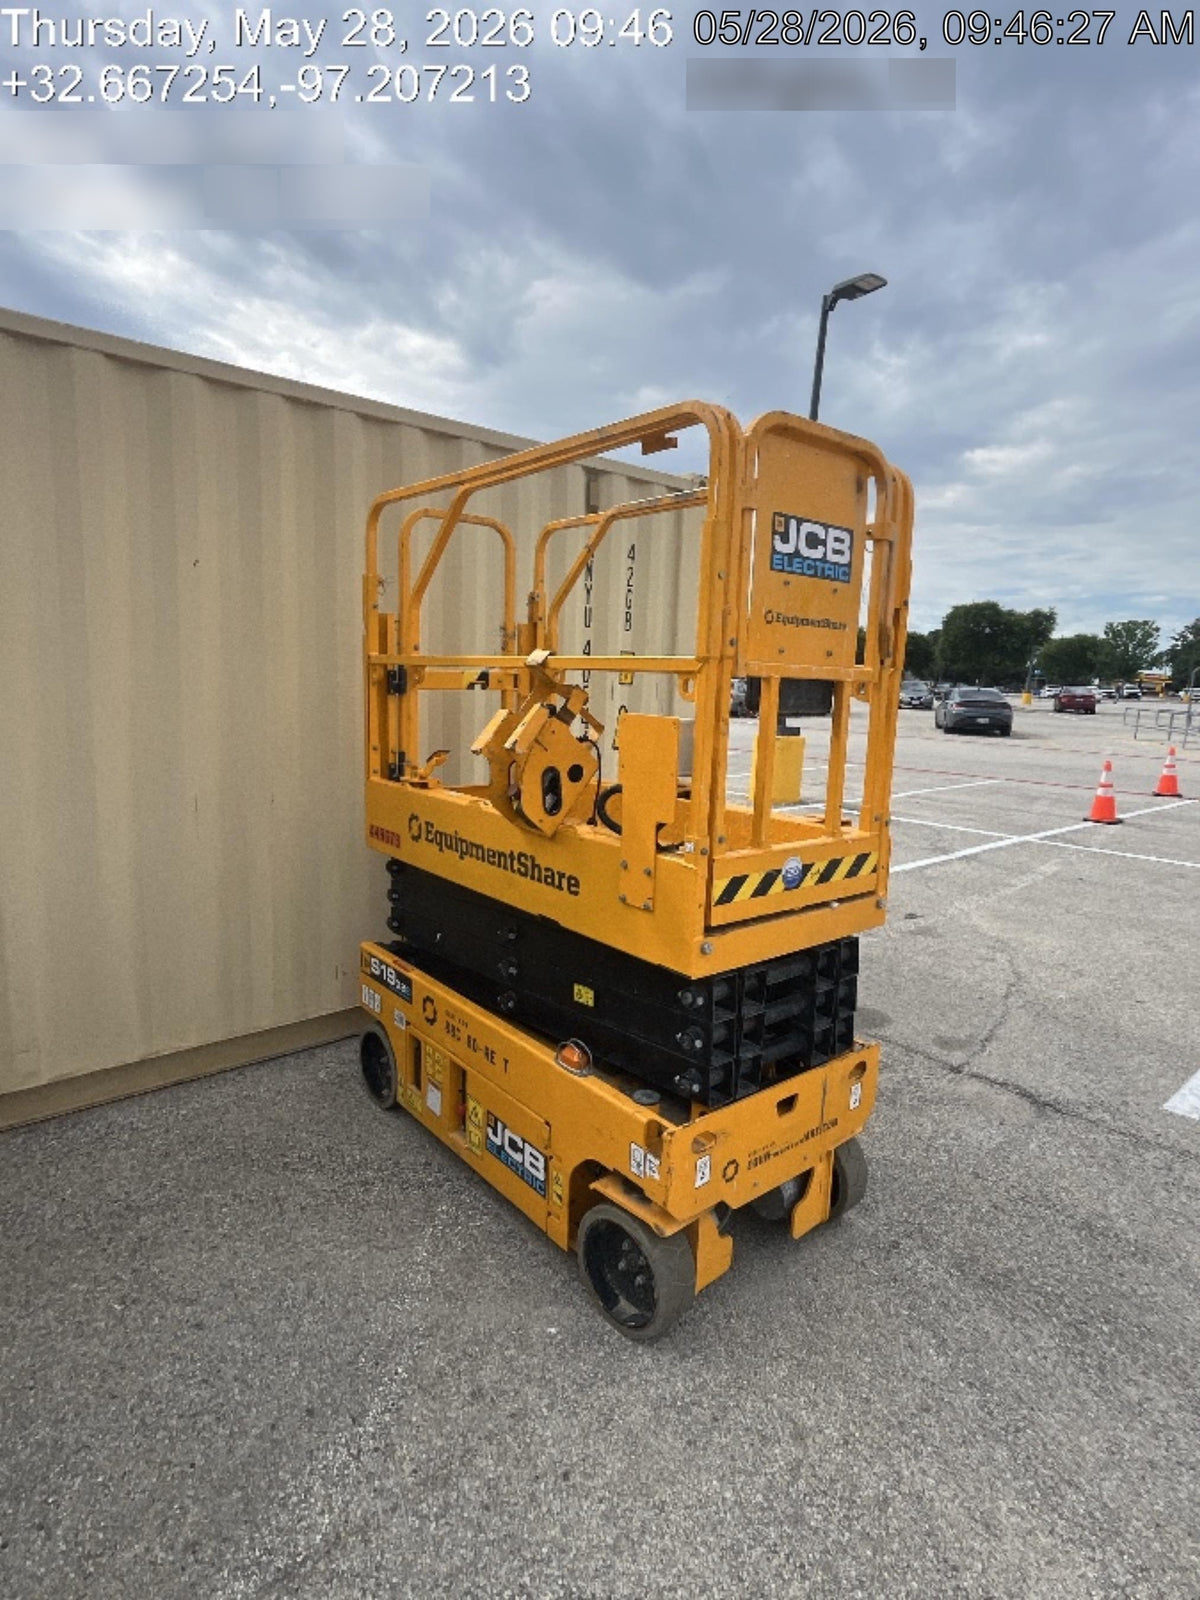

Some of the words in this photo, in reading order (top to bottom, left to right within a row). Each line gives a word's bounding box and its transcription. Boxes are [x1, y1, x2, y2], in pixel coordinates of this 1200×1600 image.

[772, 553, 850, 582] ELECTRIC
[773, 518, 851, 565] JCB
[424, 820, 580, 897] EquipmentShare
[486, 1120, 546, 1182] JCB
[486, 1139, 546, 1196] ELECTRIC
